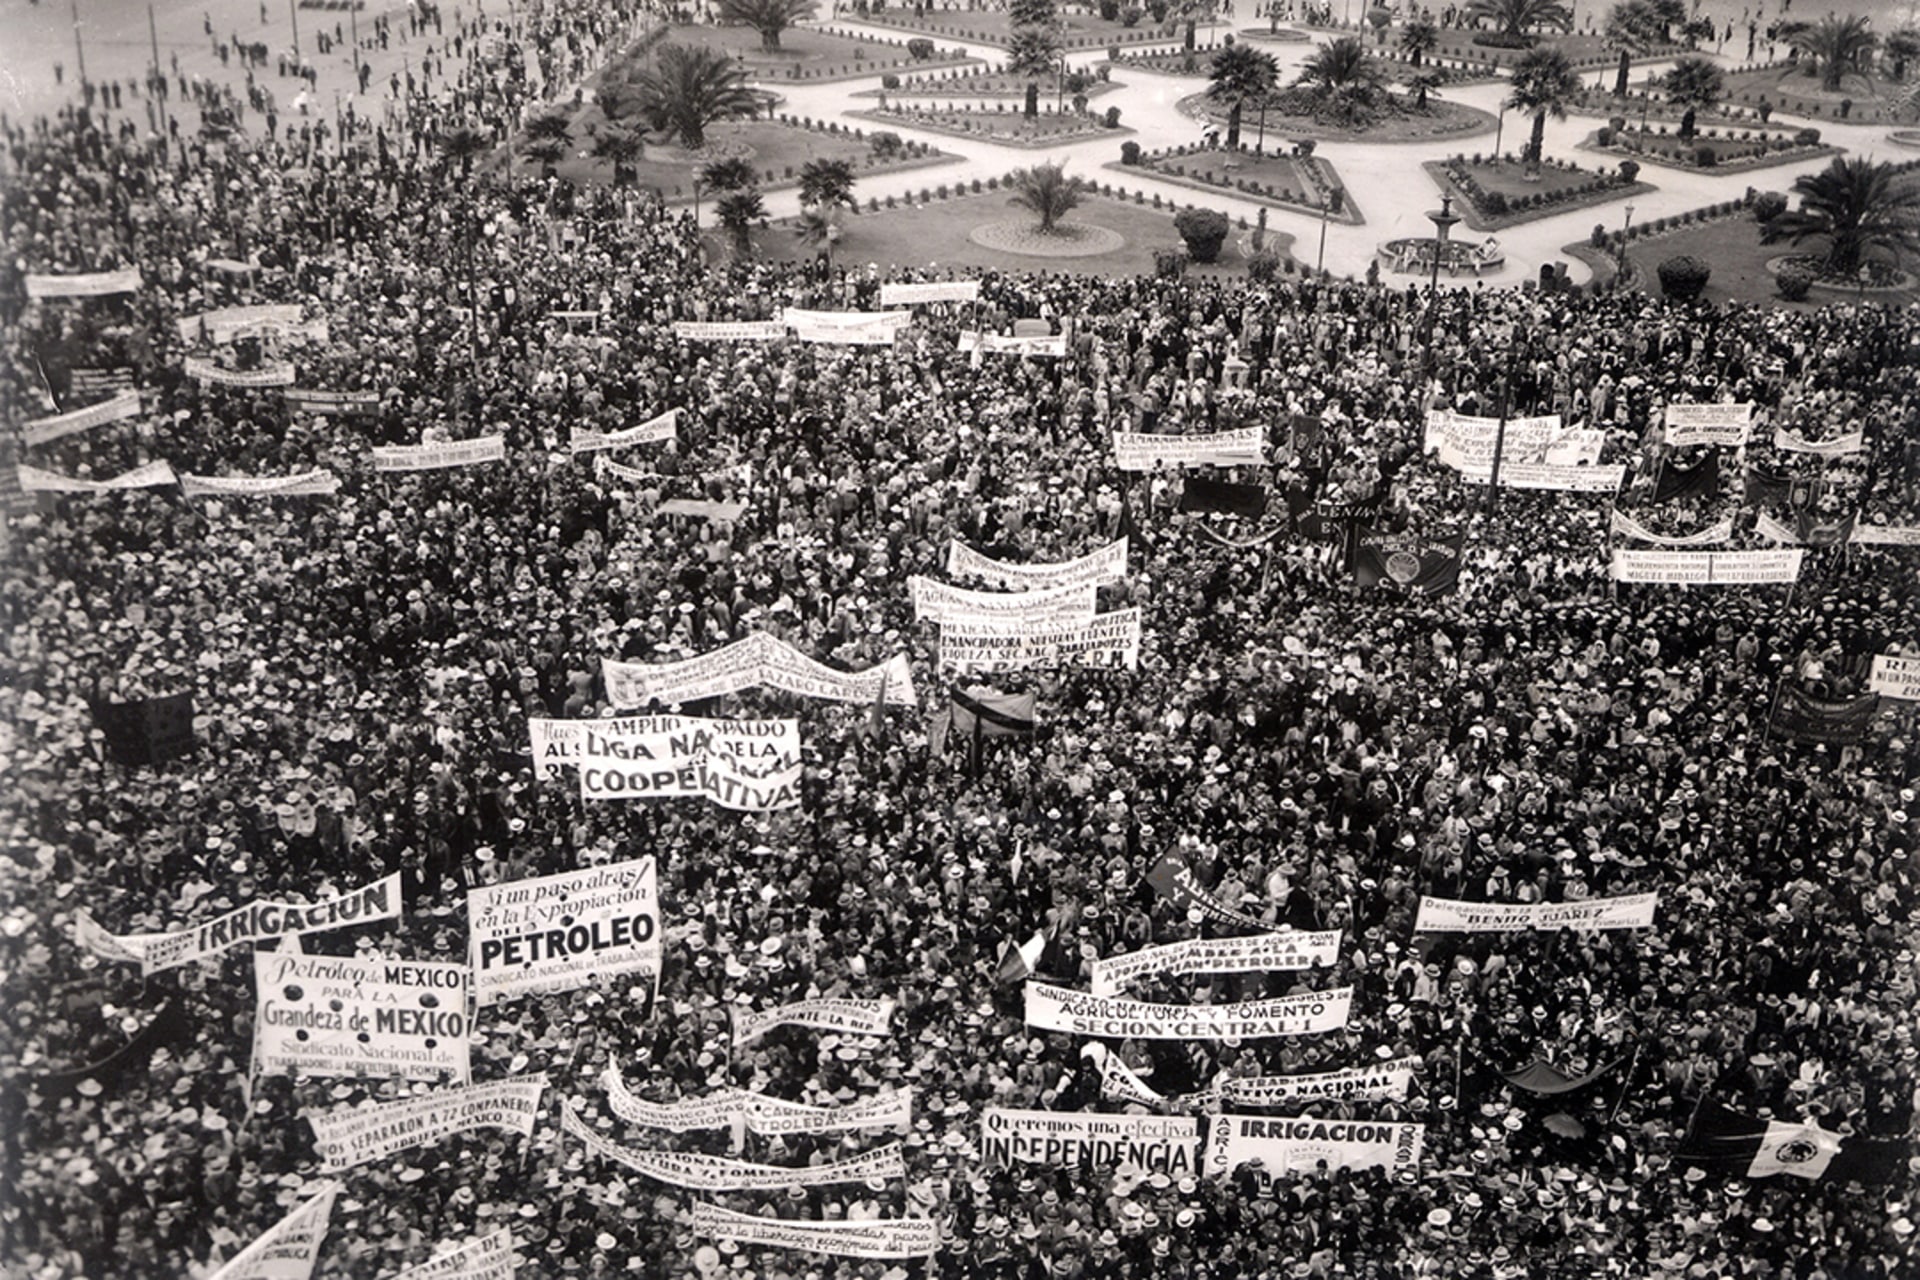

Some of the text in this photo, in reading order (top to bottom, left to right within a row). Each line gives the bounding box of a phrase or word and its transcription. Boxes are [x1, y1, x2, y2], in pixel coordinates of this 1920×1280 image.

[608, 717, 681, 736] AMPLIO
[545, 742, 571, 757] AL
[750, 742, 778, 758] LA
[585, 730, 656, 761] LIGA
[505, 890, 530, 905] un
[533, 877, 584, 904] paso
[502, 909, 518, 926] la
[481, 913, 655, 970] PETROLEO
[384, 965, 461, 989] MEXICO
[321, 986, 398, 1004] PARA LA
[1036, 985, 1109, 1009] SINDICATO
[264, 1000, 463, 1038] Grandeza de MEXICO
[1227, 1003, 1325, 1020] FOMENTO
[1073, 1018, 1164, 1036] SECION
[1173, 1019, 1293, 1037] CENTRAL
[281, 1039, 455, 1063] Sindicato Nacional de
[1296, 1076, 1393, 1096] NACIONAL
[349, 1115, 424, 1152] SEPARARON
[428, 1112, 439, 1126] A
[460, 1096, 533, 1117] COMPAÑEROS
[748, 1117, 837, 1131] ETROLERA
[987, 1113, 1195, 1139] Queremos una efectiva
[1240, 1119, 1394, 1144] IRRIGACION
[983, 1136, 1190, 1174] INDEPENDENCIA
